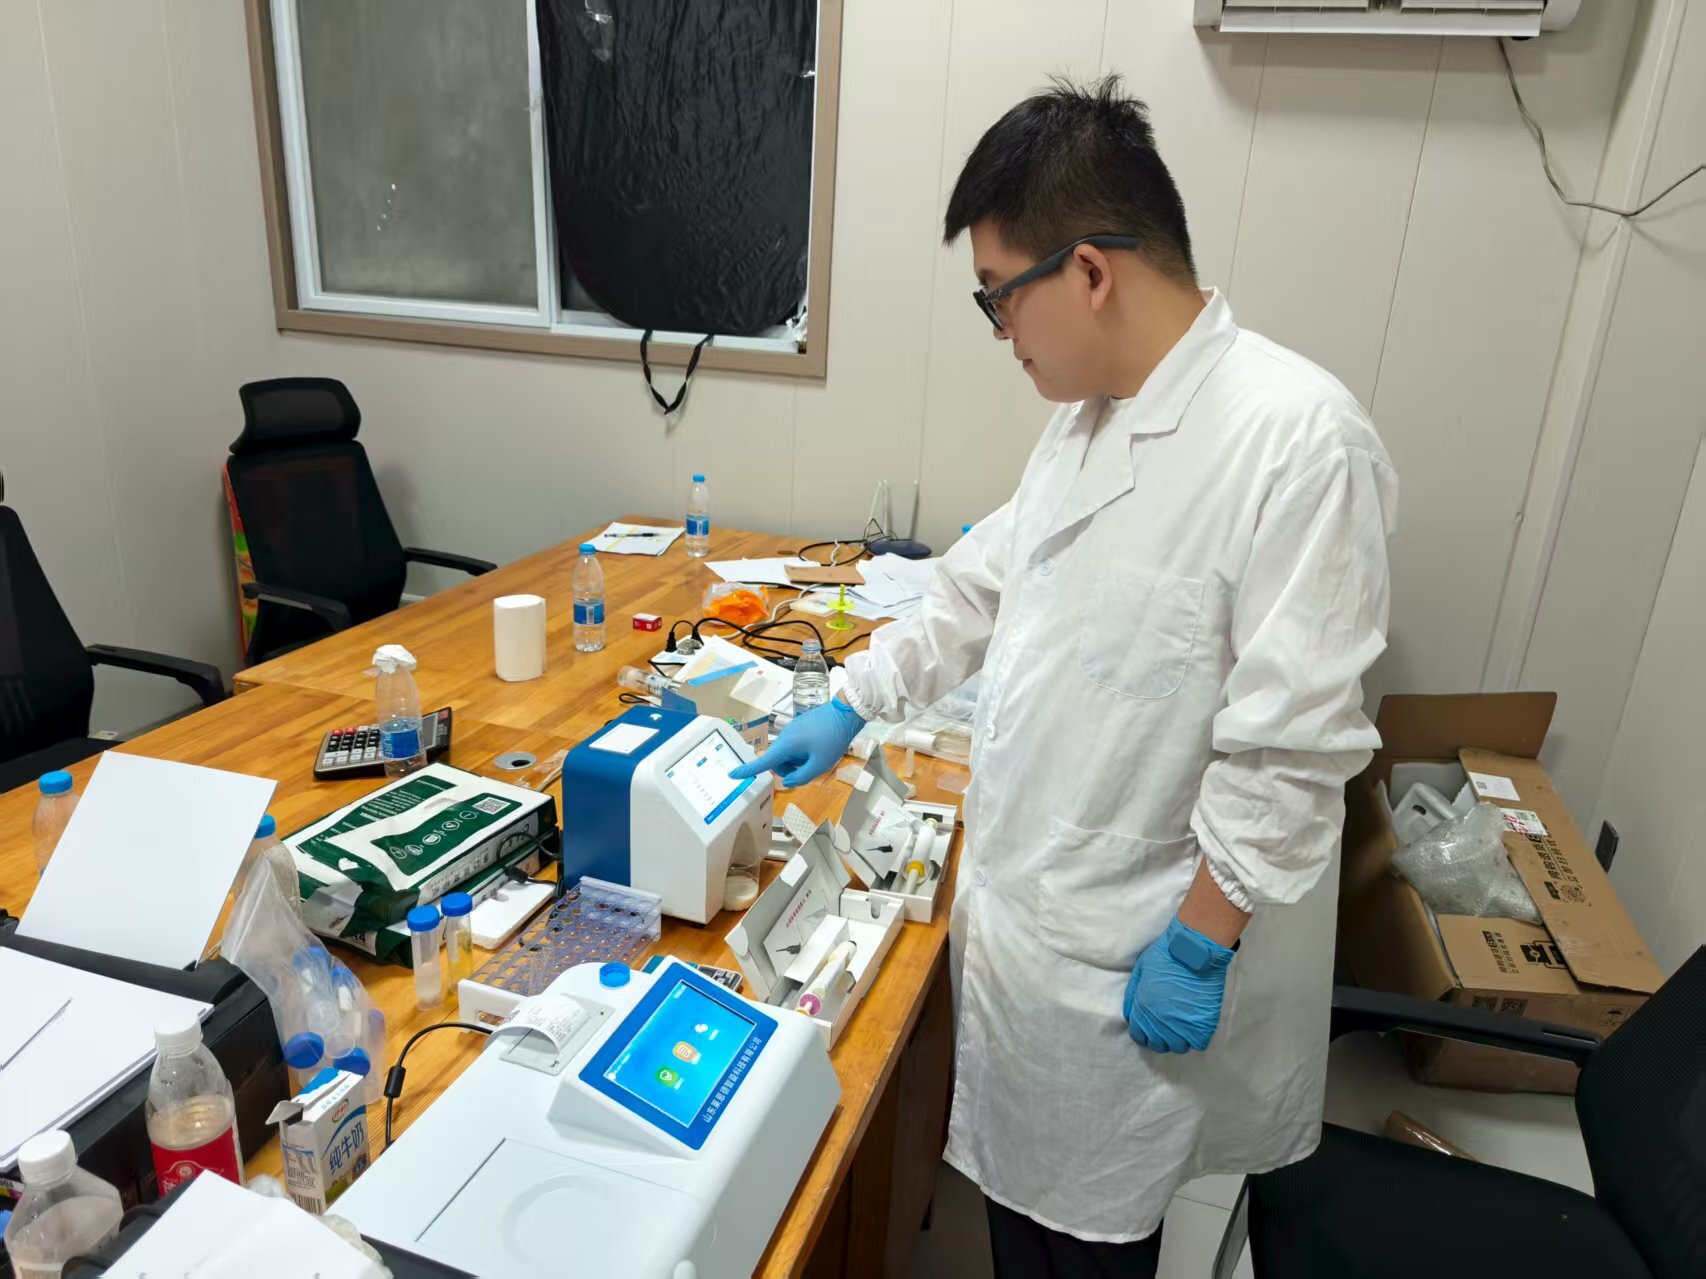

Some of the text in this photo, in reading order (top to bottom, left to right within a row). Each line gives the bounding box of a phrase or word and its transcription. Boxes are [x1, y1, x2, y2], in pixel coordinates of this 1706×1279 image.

[702, 1036, 763, 1123] 山东莱恩德智能科技有限公司
[329, 1121, 365, 1175] 纯牛奶
